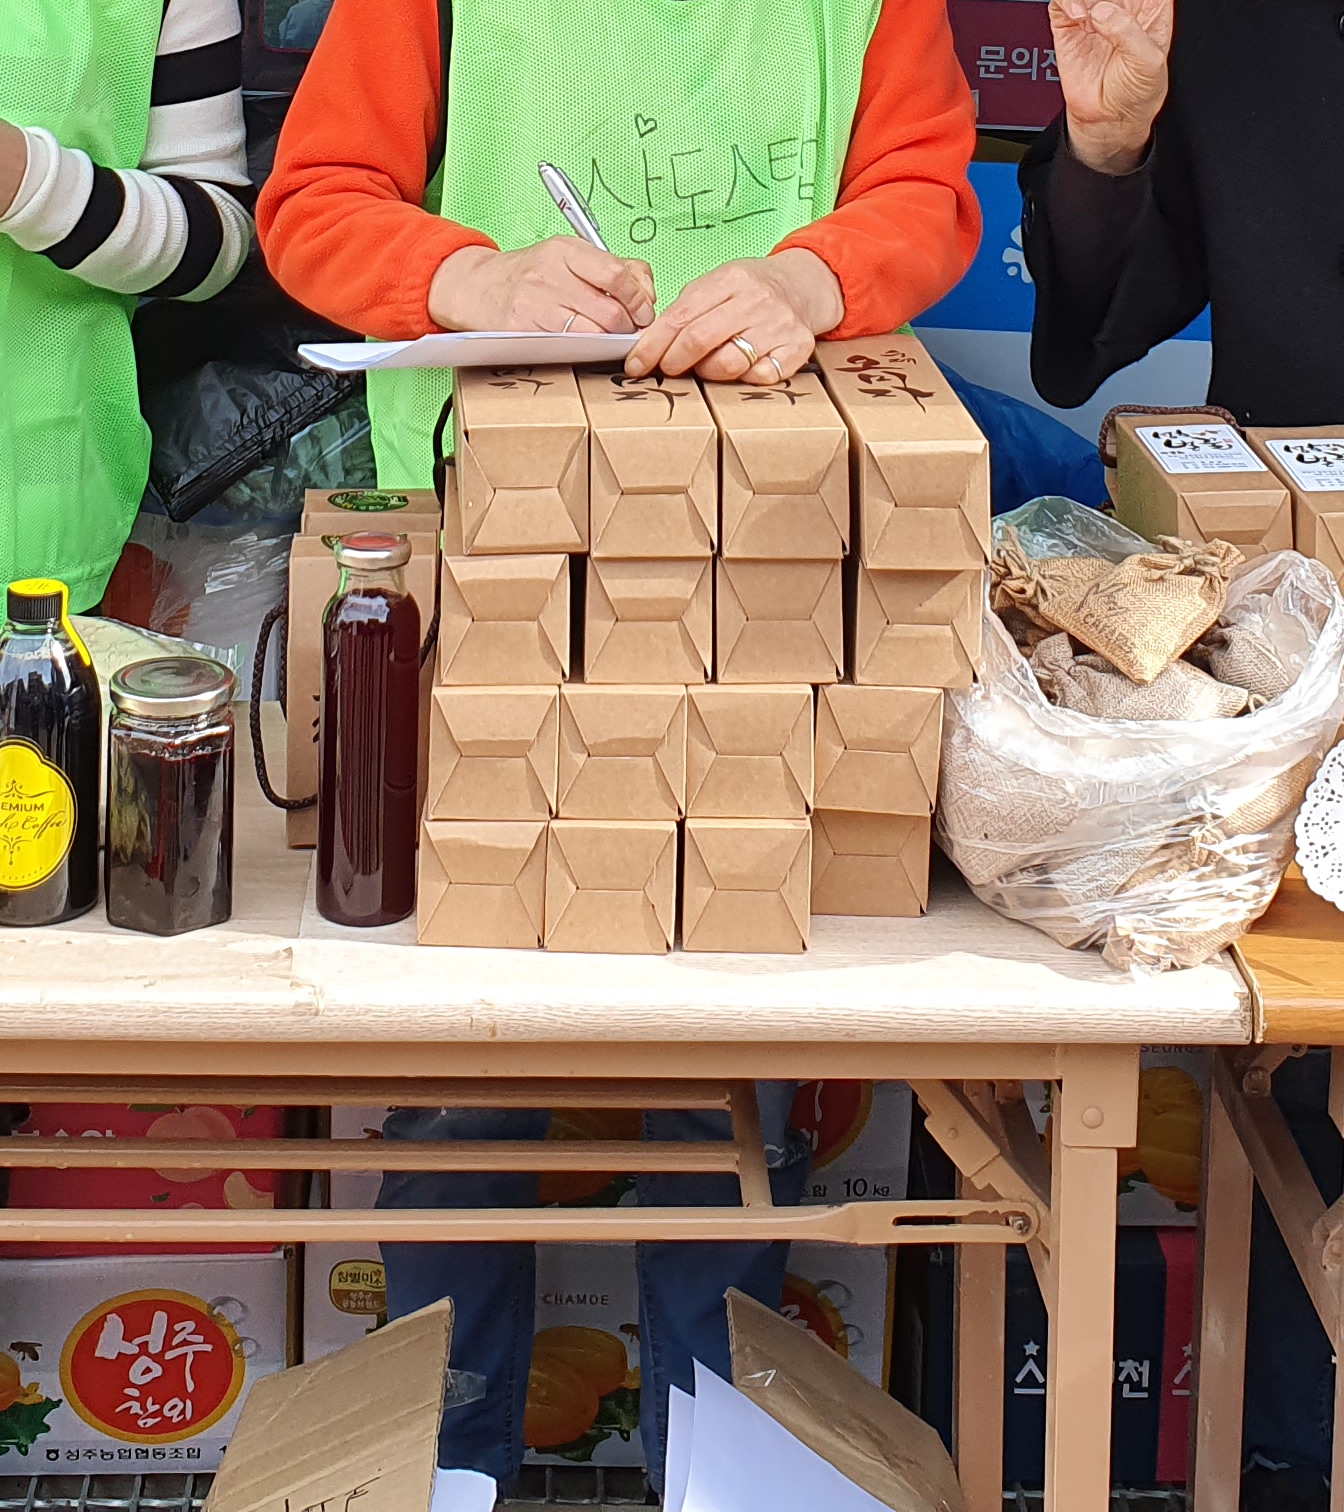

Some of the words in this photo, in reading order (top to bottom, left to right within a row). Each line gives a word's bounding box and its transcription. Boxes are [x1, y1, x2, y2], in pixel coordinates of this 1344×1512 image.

[20, 810, 67, 839] Coffee
[842, 1178, 868, 1197] 10
[872, 1184, 890, 1199] kg
[542, 1292, 610, 1306] CHAMOE
[95, 1310, 214, 1394] 성주
[115, 1389, 193, 1428] 참외
